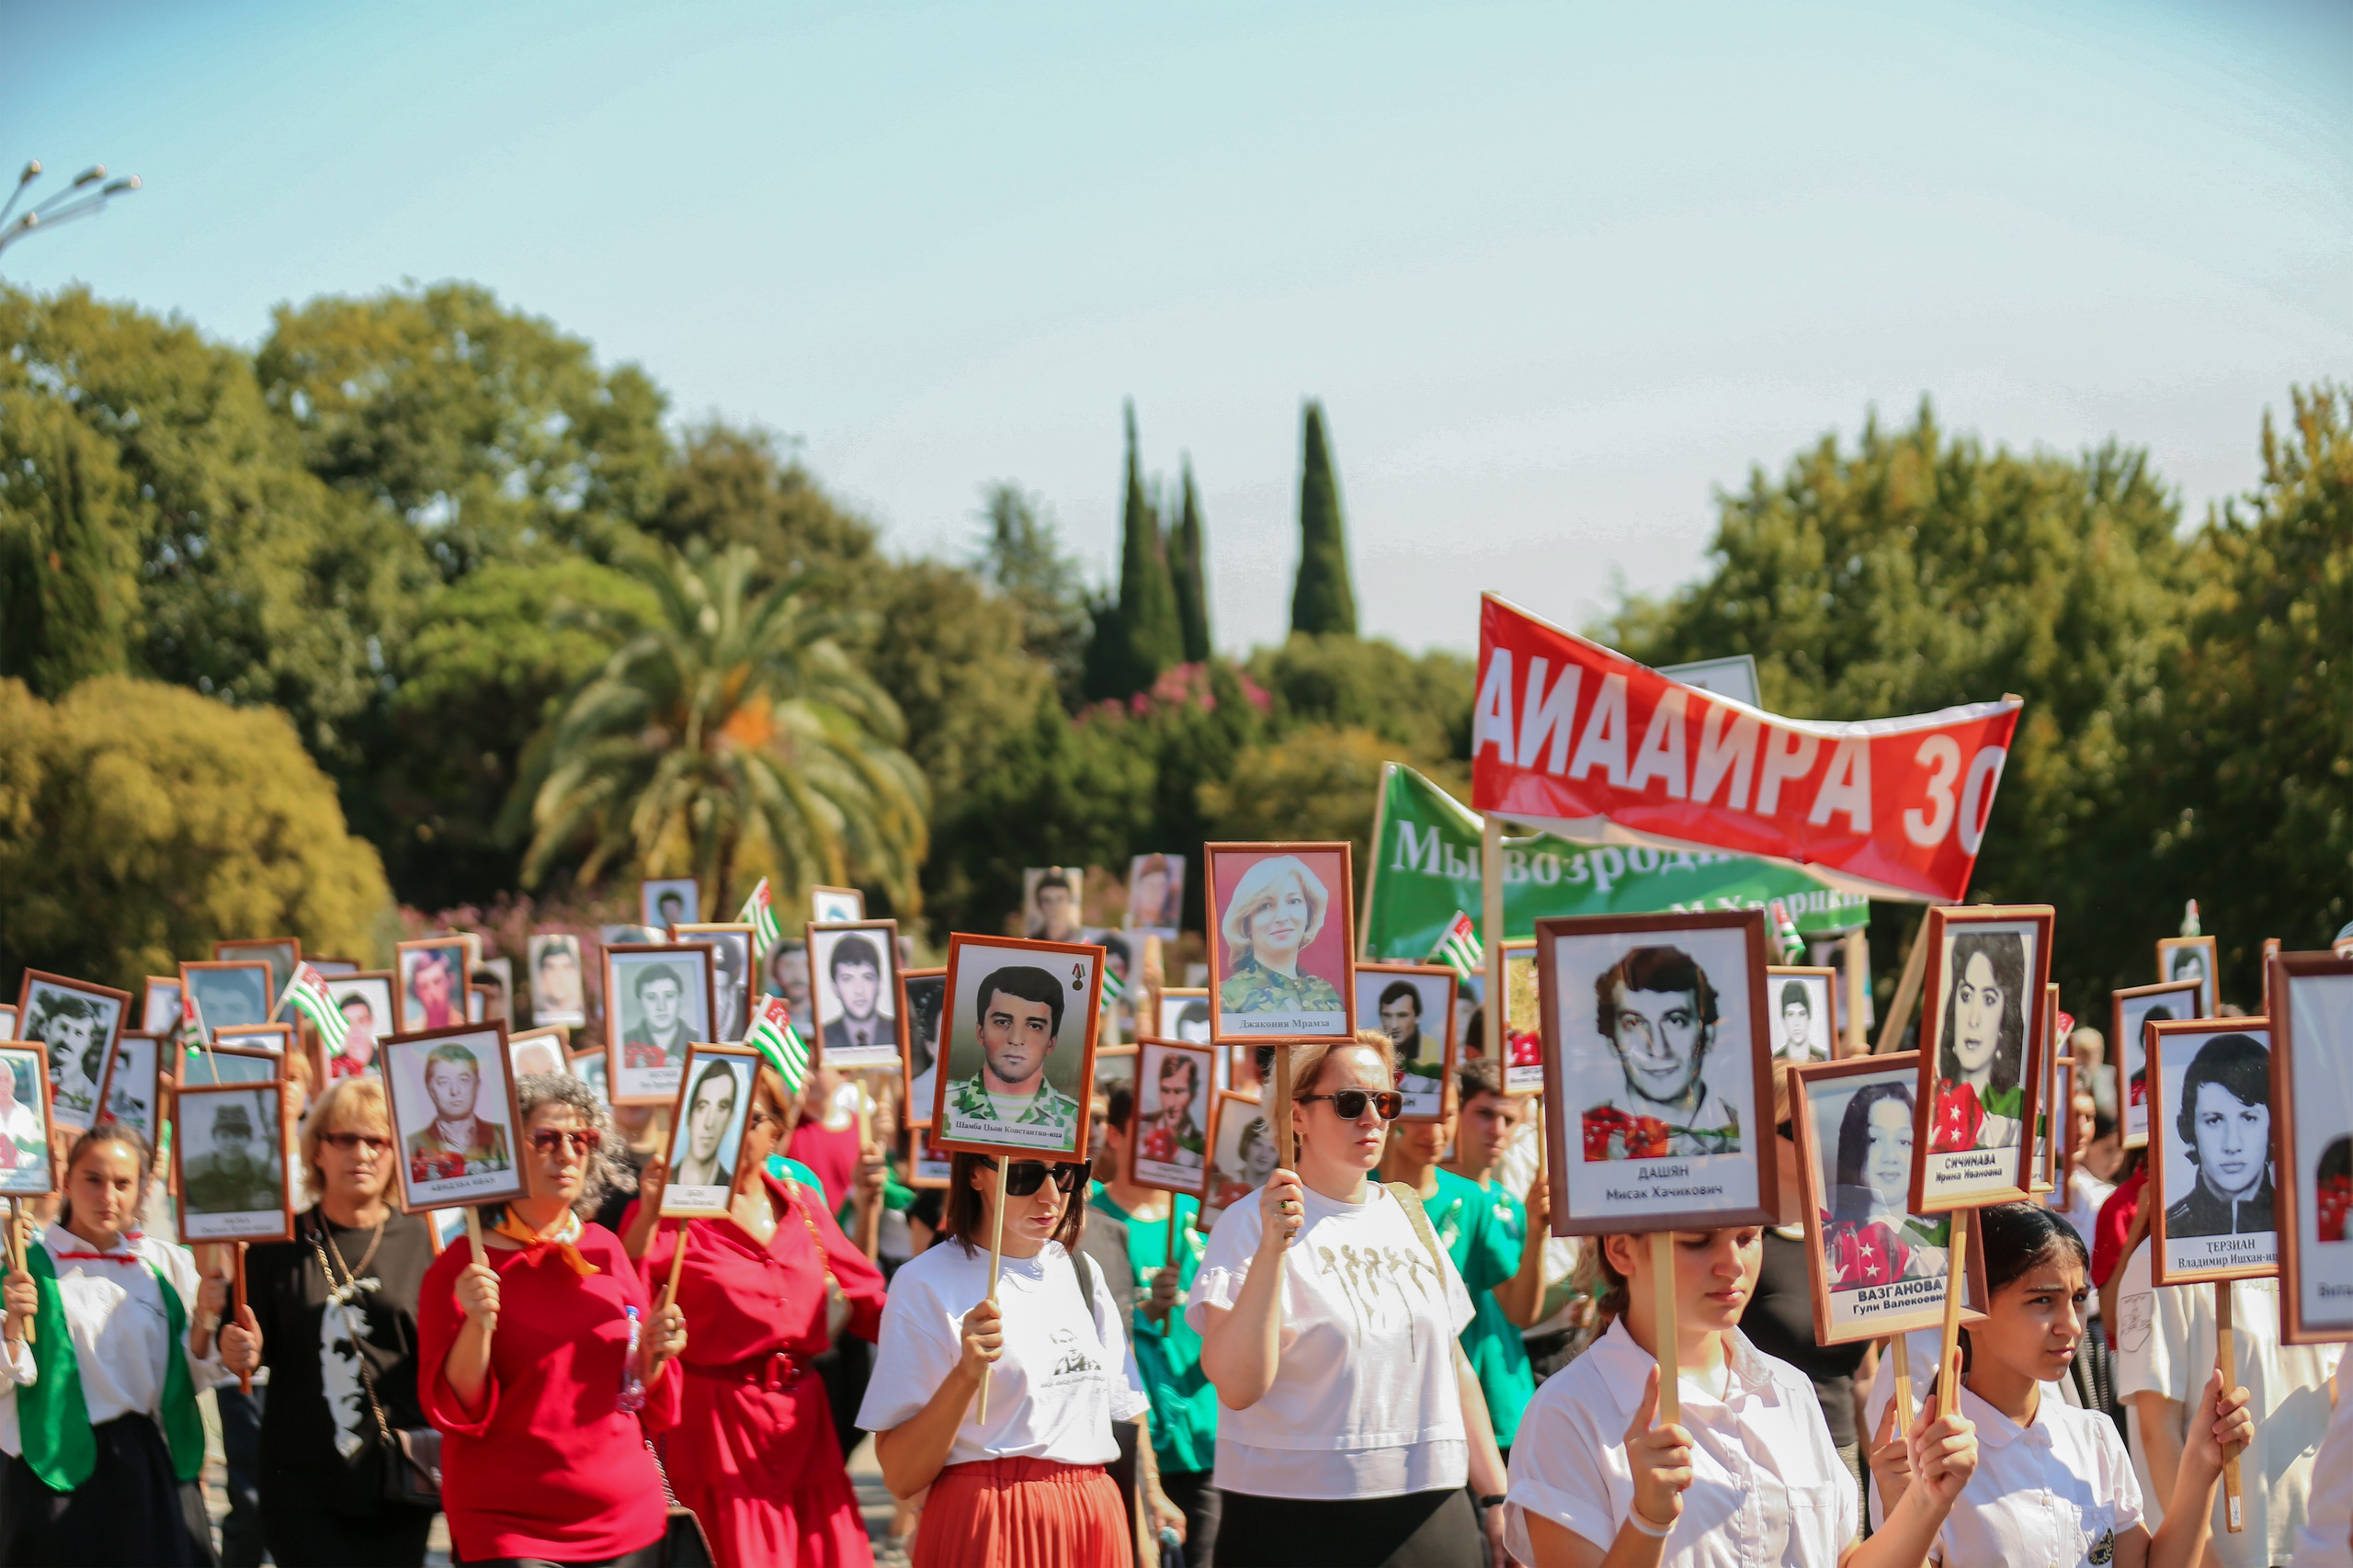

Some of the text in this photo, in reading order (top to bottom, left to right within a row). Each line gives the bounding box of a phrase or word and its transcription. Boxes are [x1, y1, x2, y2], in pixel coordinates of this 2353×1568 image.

[1904, 734, 2006, 855] 30
[1391, 820, 1750, 892] Мы возрод
[1239, 1019, 1330, 1028] Джакония Мрамза
[956, 1121, 982, 1131] Шамба
[1945, 1153, 1995, 1169] СИЧИНАВА
[1638, 1165, 1689, 1180] ДАШЯН
[1935, 1167, 2003, 1184] Ирина Ивановна
[1606, 1185, 1723, 1200] Мисак Хачикович
[2178, 1256, 2228, 1268] Владимир
[1858, 1278, 1943, 1302] ВАЗГАНОВА
[1853, 1301, 1880, 1315] Гули
